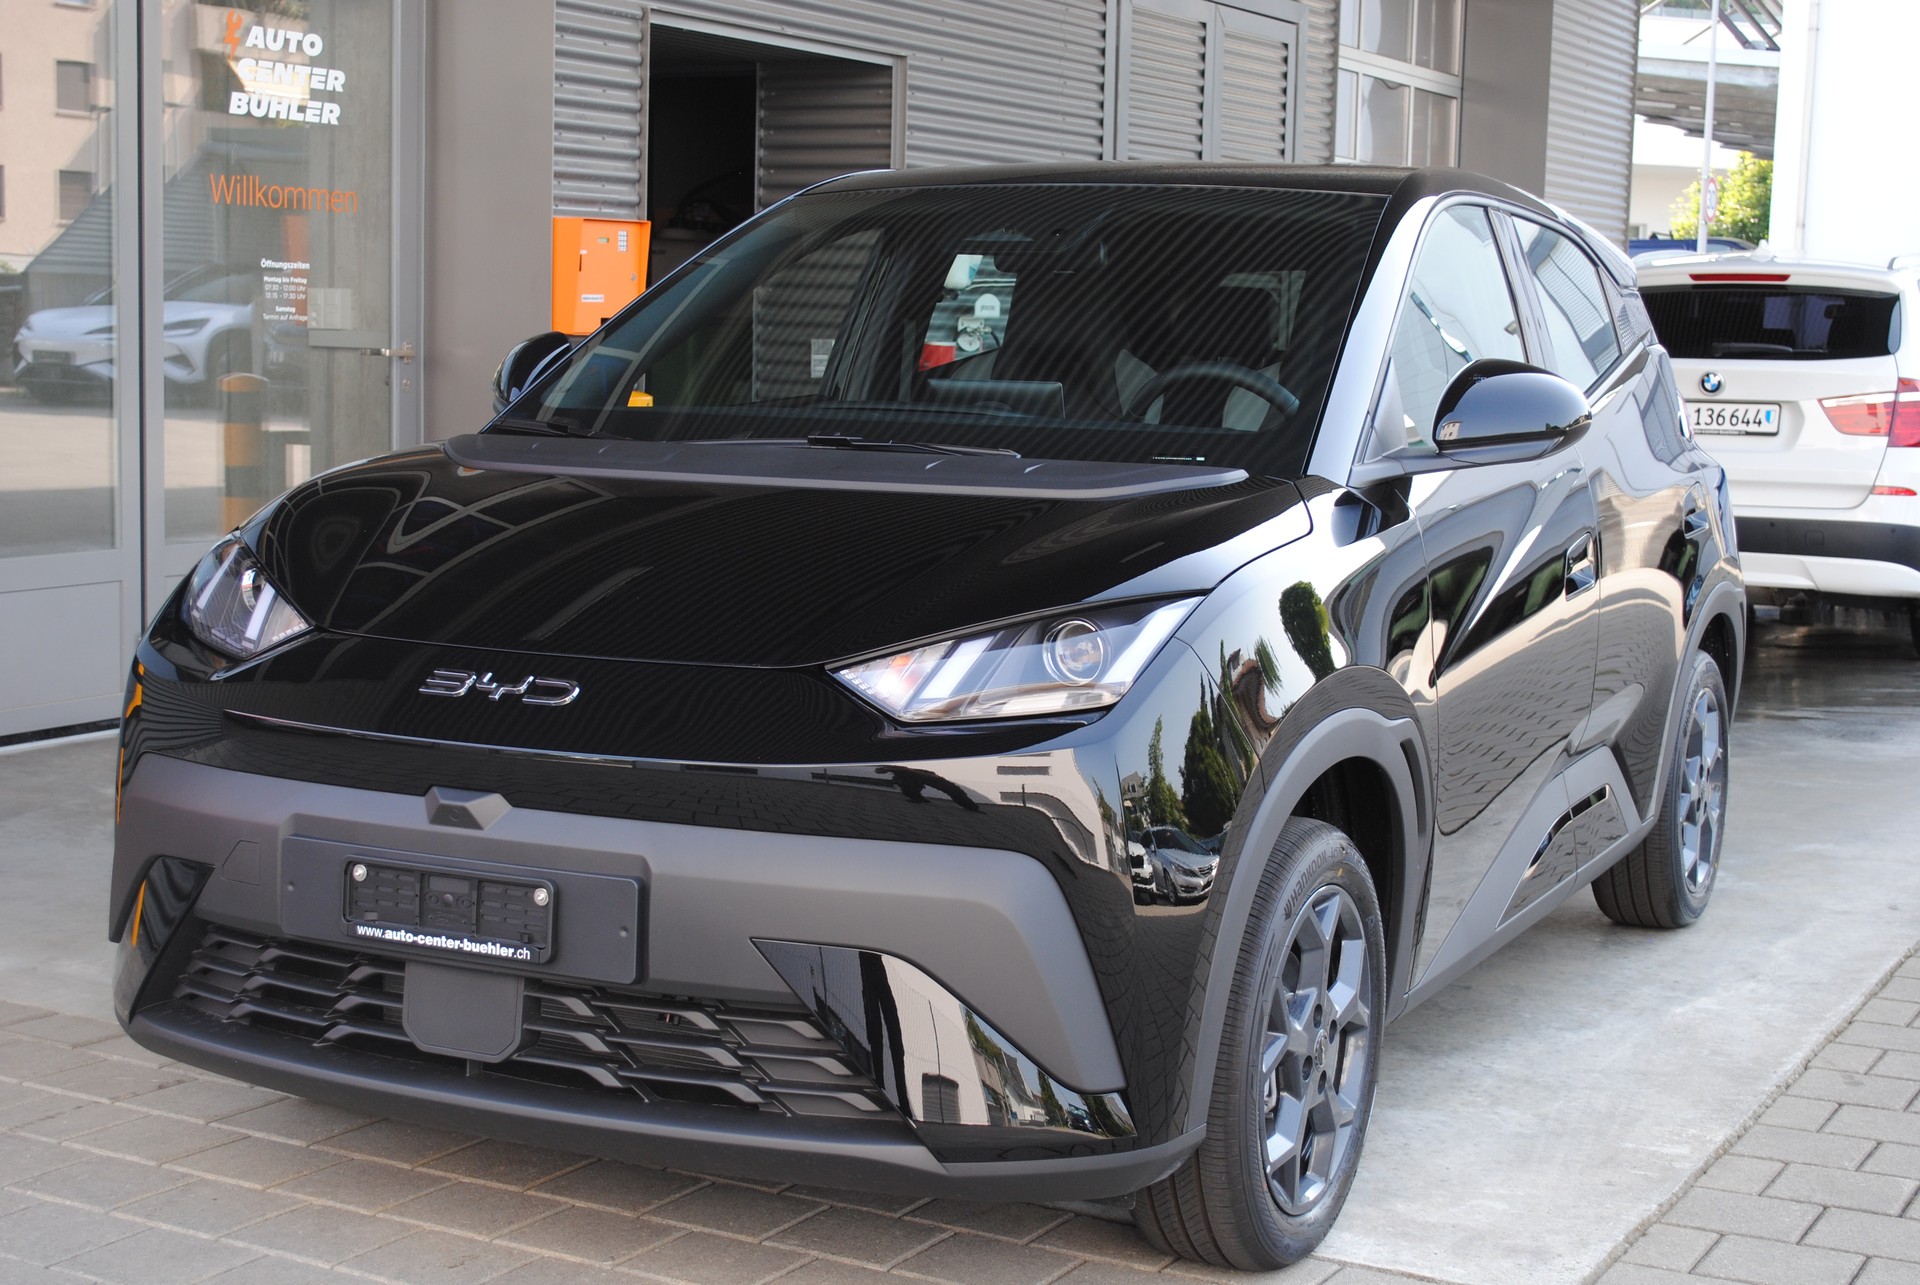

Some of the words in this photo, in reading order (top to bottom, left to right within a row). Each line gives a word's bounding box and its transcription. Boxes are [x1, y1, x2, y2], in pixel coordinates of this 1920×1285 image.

[245, 25, 323, 57] AUTO
[237, 58, 346, 92] CENTER
[229, 87, 341, 125] BÜHLER
[210, 173, 358, 214] Willkommen
[260, 258, 310, 270] Öffnungszeiten
[419, 667, 580, 706] BYD
[356, 924, 531, 961] www.auto-center-buehler.ch
